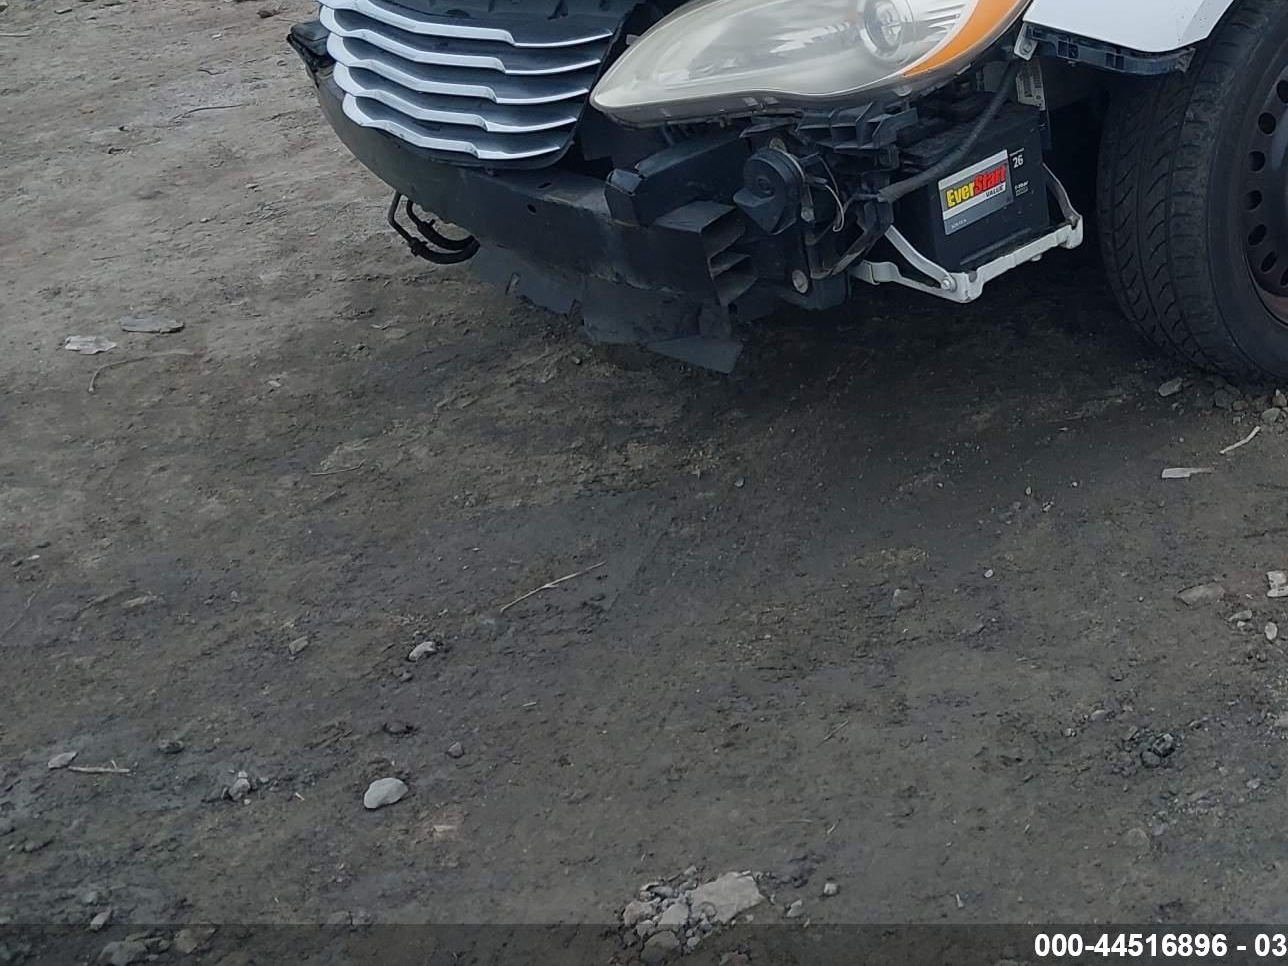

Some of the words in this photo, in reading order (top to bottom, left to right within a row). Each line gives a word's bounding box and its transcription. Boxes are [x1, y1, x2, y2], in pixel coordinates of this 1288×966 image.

[1012, 154, 1024, 169] 26
[946, 164, 1007, 208] EverStart
[985, 184, 1004, 198] VALUE
